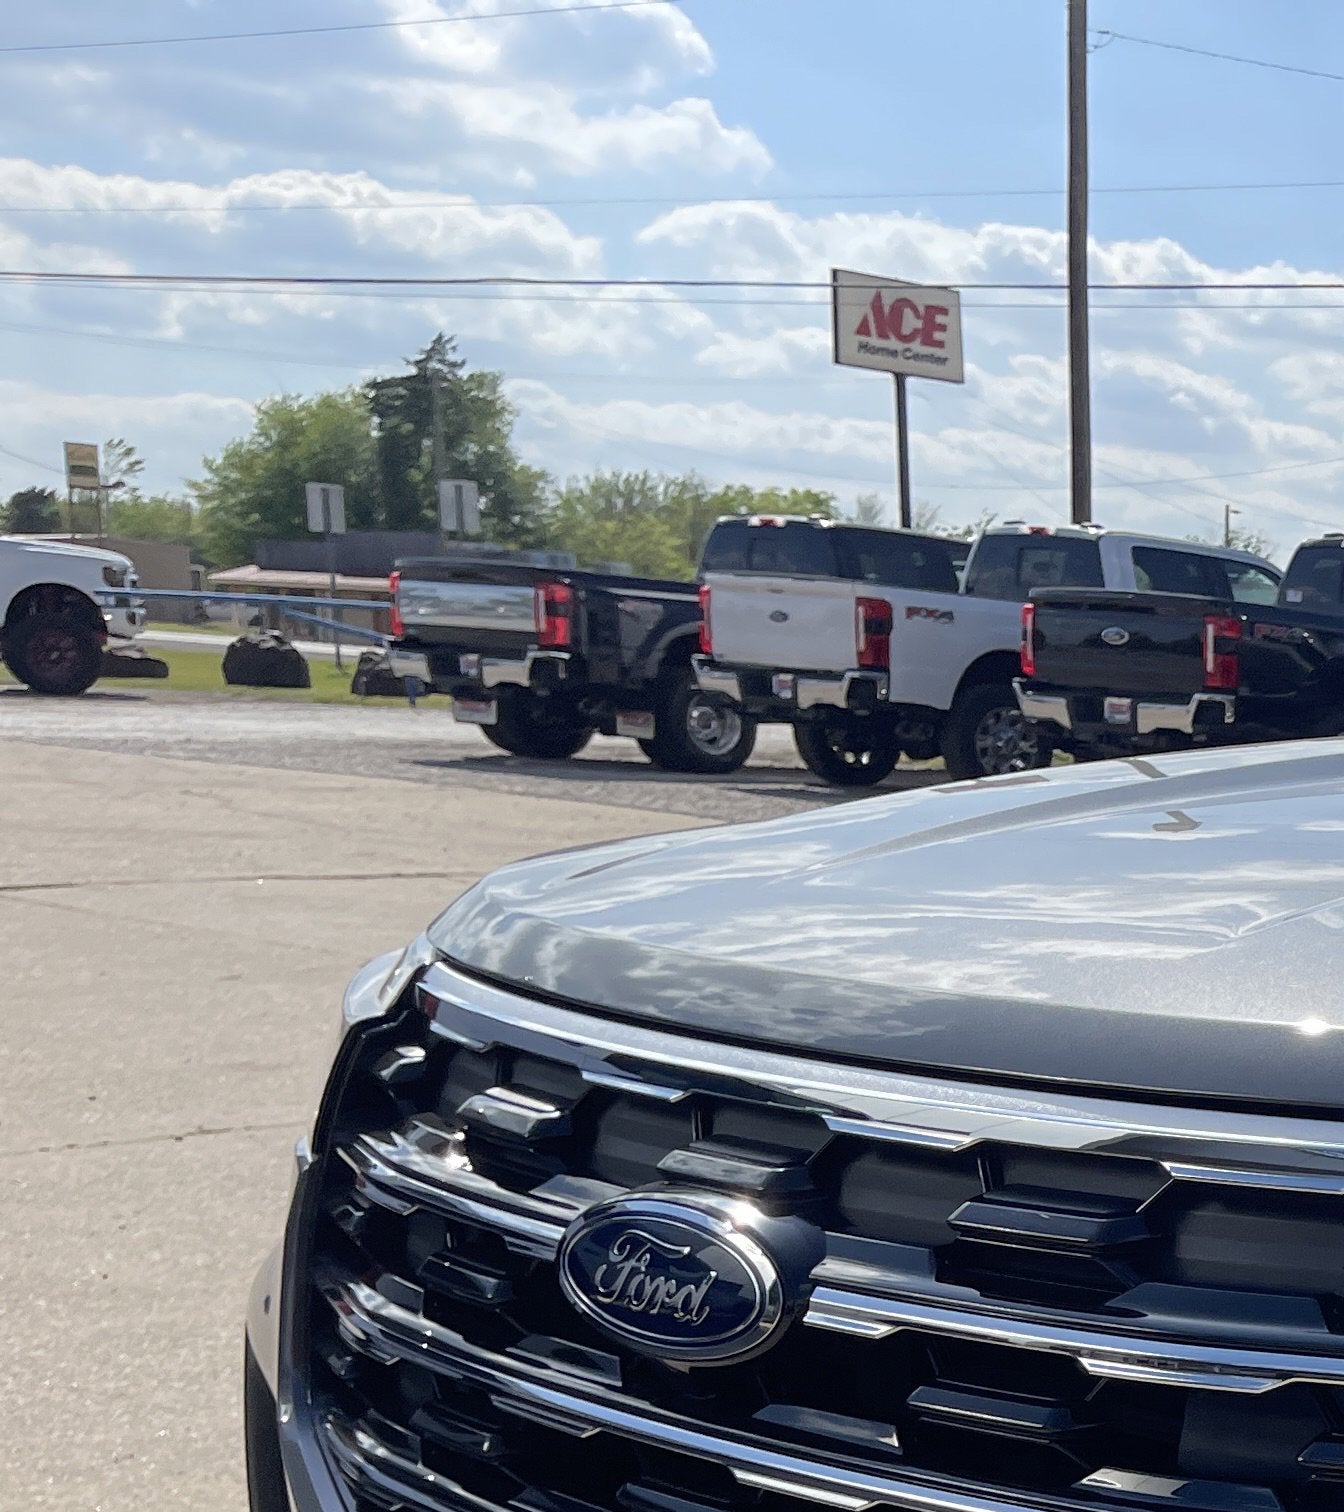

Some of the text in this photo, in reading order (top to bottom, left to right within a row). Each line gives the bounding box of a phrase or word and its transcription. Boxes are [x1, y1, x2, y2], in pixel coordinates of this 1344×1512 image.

[855, 289, 948, 348] ACE
[858, 341, 948, 365] Home Center
[594, 1228, 718, 1326] Ford
